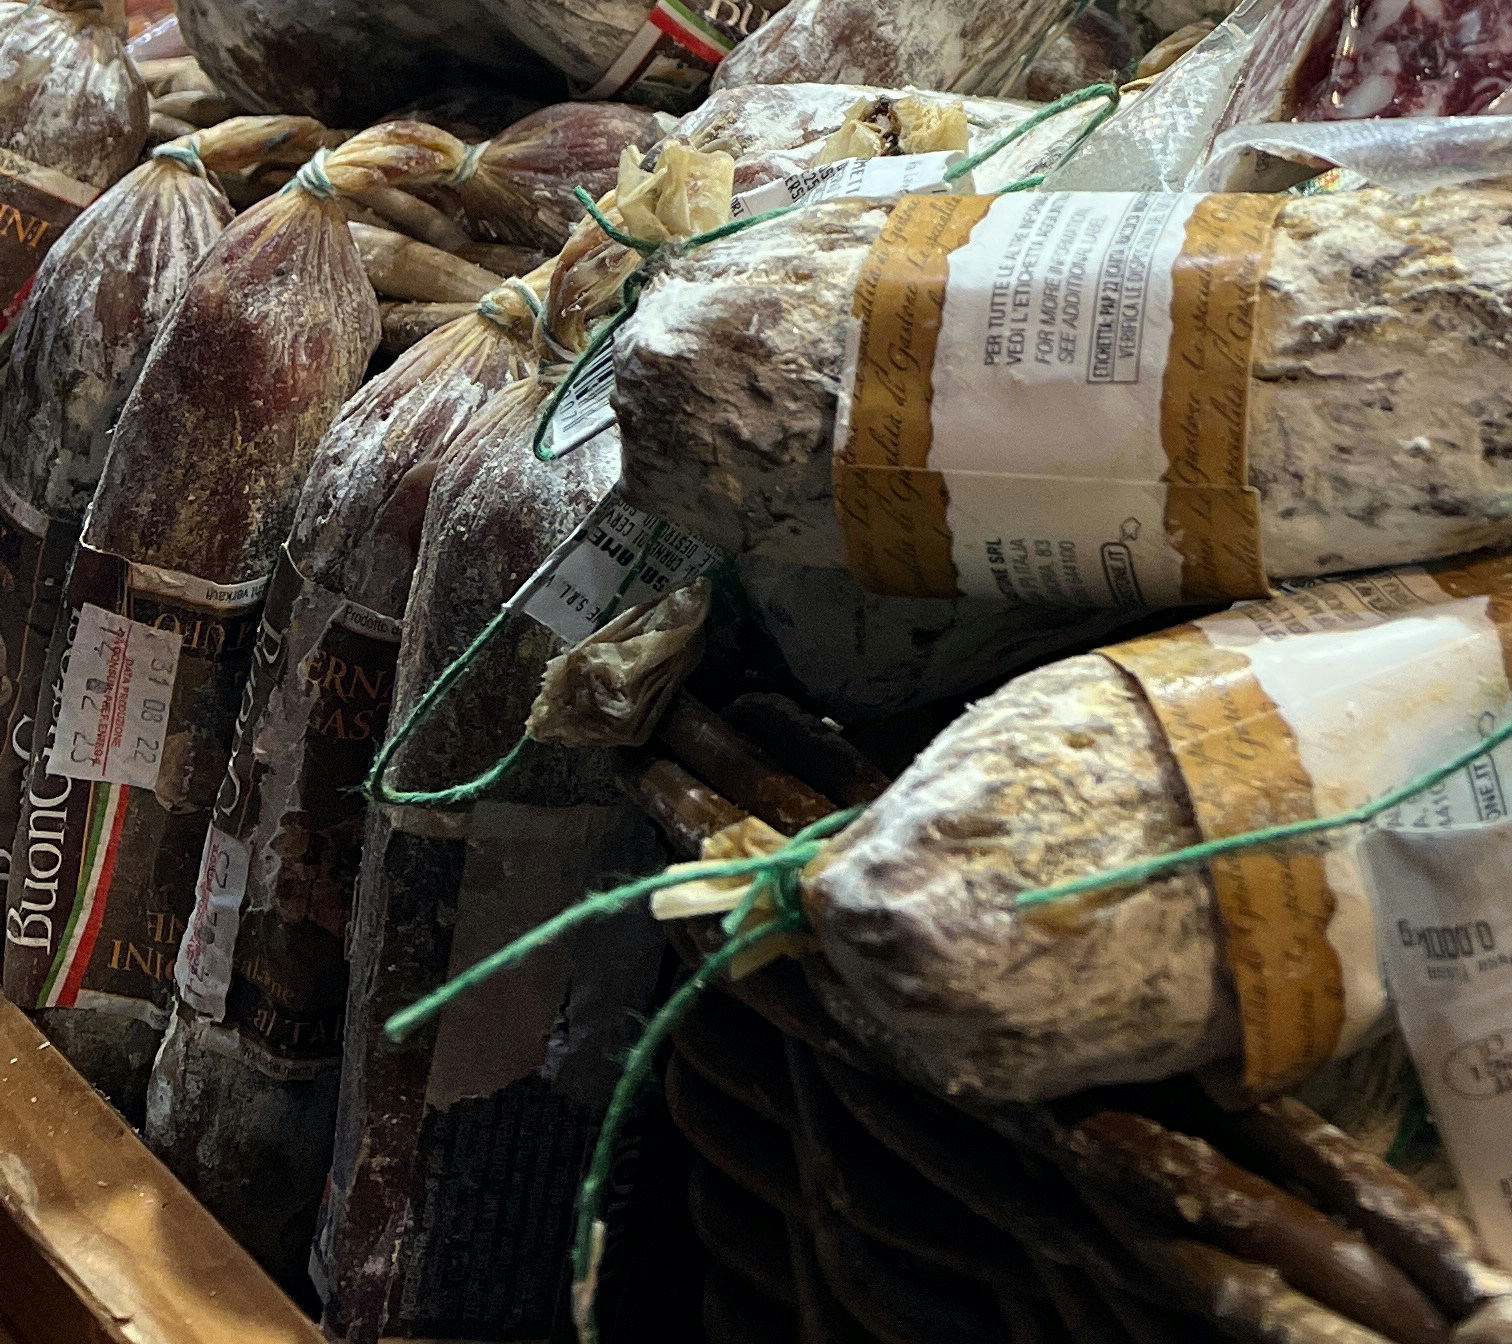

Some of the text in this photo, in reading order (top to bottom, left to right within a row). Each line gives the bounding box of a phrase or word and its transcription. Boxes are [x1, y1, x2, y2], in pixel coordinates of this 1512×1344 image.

[988, 279, 1010, 329] TUTTE
[1039, 275, 1063, 330] MORE
[889, 281, 920, 380] Gastone
[984, 335, 1001, 366] PER
[1006, 327, 1026, 366] VEDI
[1034, 328, 1055, 366] FOR
[1058, 329, 1077, 365] SEE
[1173, 393, 1202, 484] Gastone
[344, 606, 388, 634] Prodotto
[111, 657, 135, 750] DATA PRODUZIONE
[134, 658, 173, 764] 31 08 22
